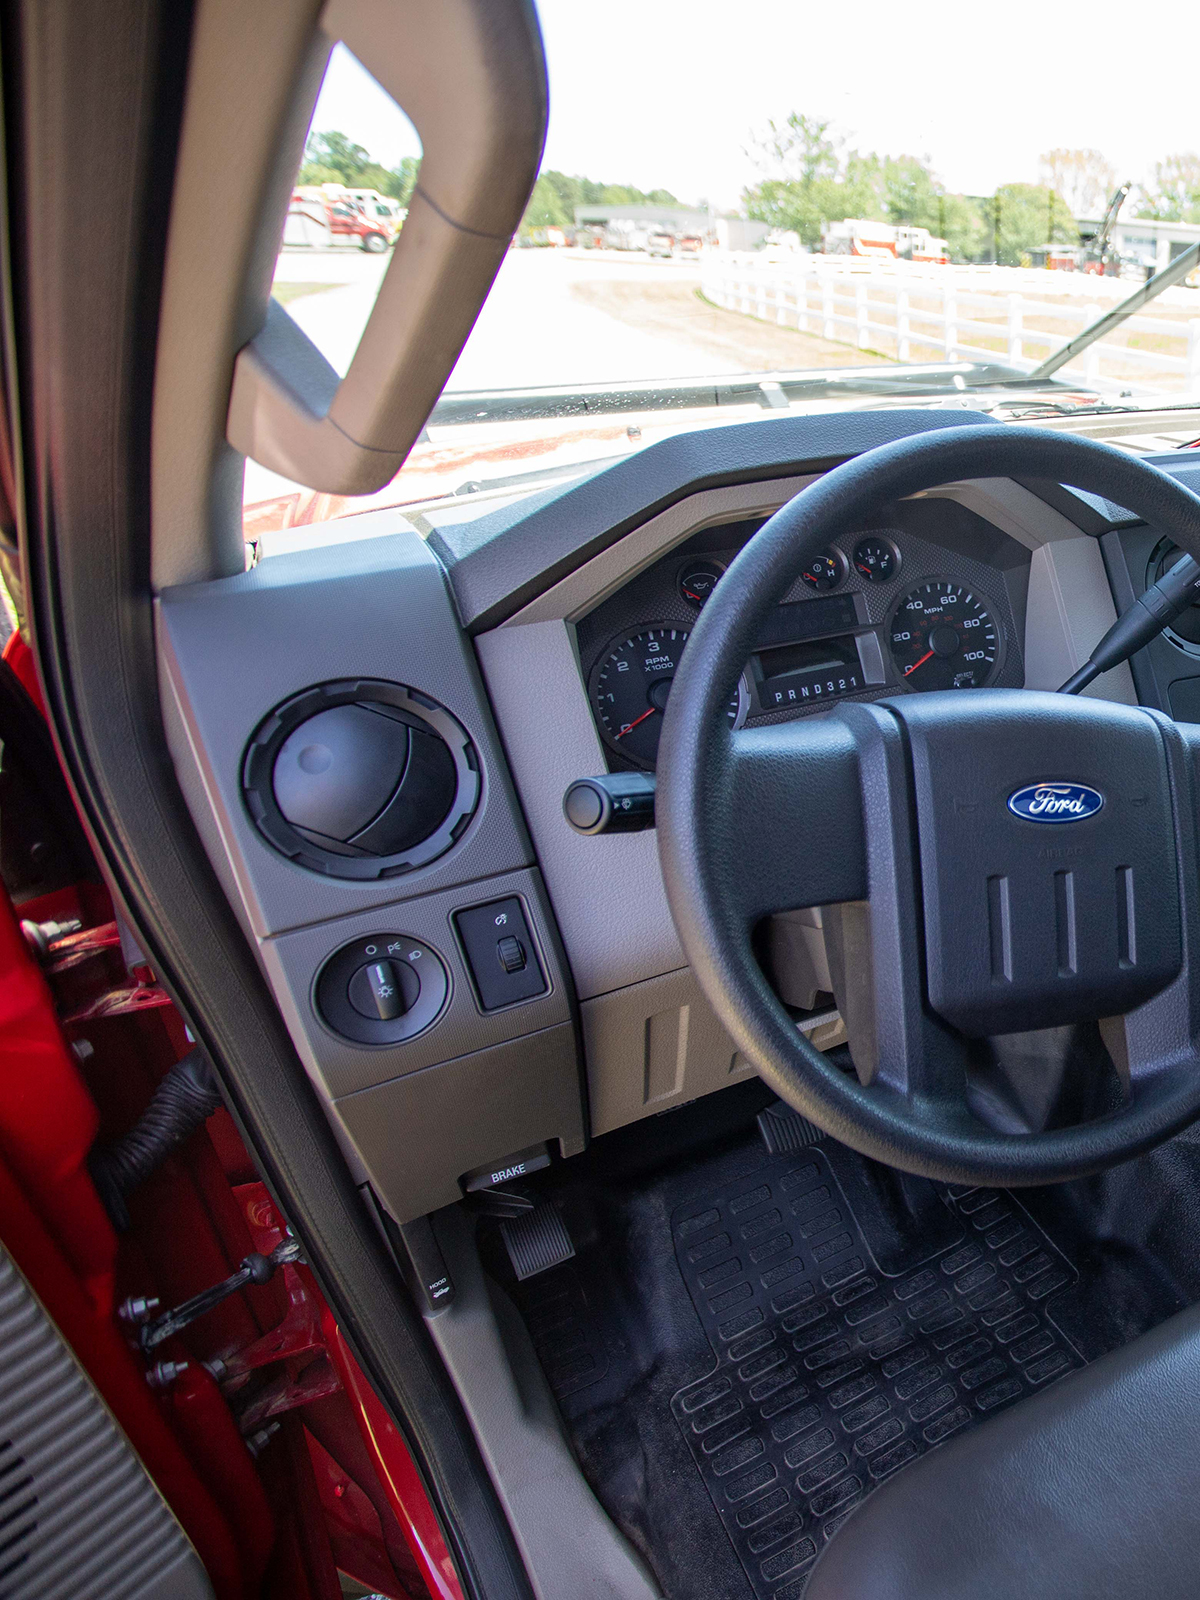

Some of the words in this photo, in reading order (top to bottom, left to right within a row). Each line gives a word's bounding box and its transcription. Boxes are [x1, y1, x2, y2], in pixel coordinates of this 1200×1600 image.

[880, 561, 887, 569] F
[827, 569, 835, 577] H
[905, 600, 923, 610] 40
[940, 594, 957, 605] 60
[923, 606, 943, 615] MPH
[963, 618, 980, 629] 80
[893, 631, 911, 642] 20
[648, 641, 660, 652] 3
[645, 655, 669, 665] RPM
[963, 650, 985, 661] 100
[616, 661, 630, 672] 2
[775, 692, 783, 703] P
[788, 689, 796, 700] R
[801, 686, 809, 697] N
[814, 684, 822, 694] D
[827, 681, 835, 692] 3
[839, 679, 847, 690] 2
[850, 676, 857, 687] 1
[606, 692, 615, 703] 1
[1028, 788, 1085, 814] Ford
[491, 1163, 526, 1183] BRAKE
[429, 1277, 447, 1290] HOOD
